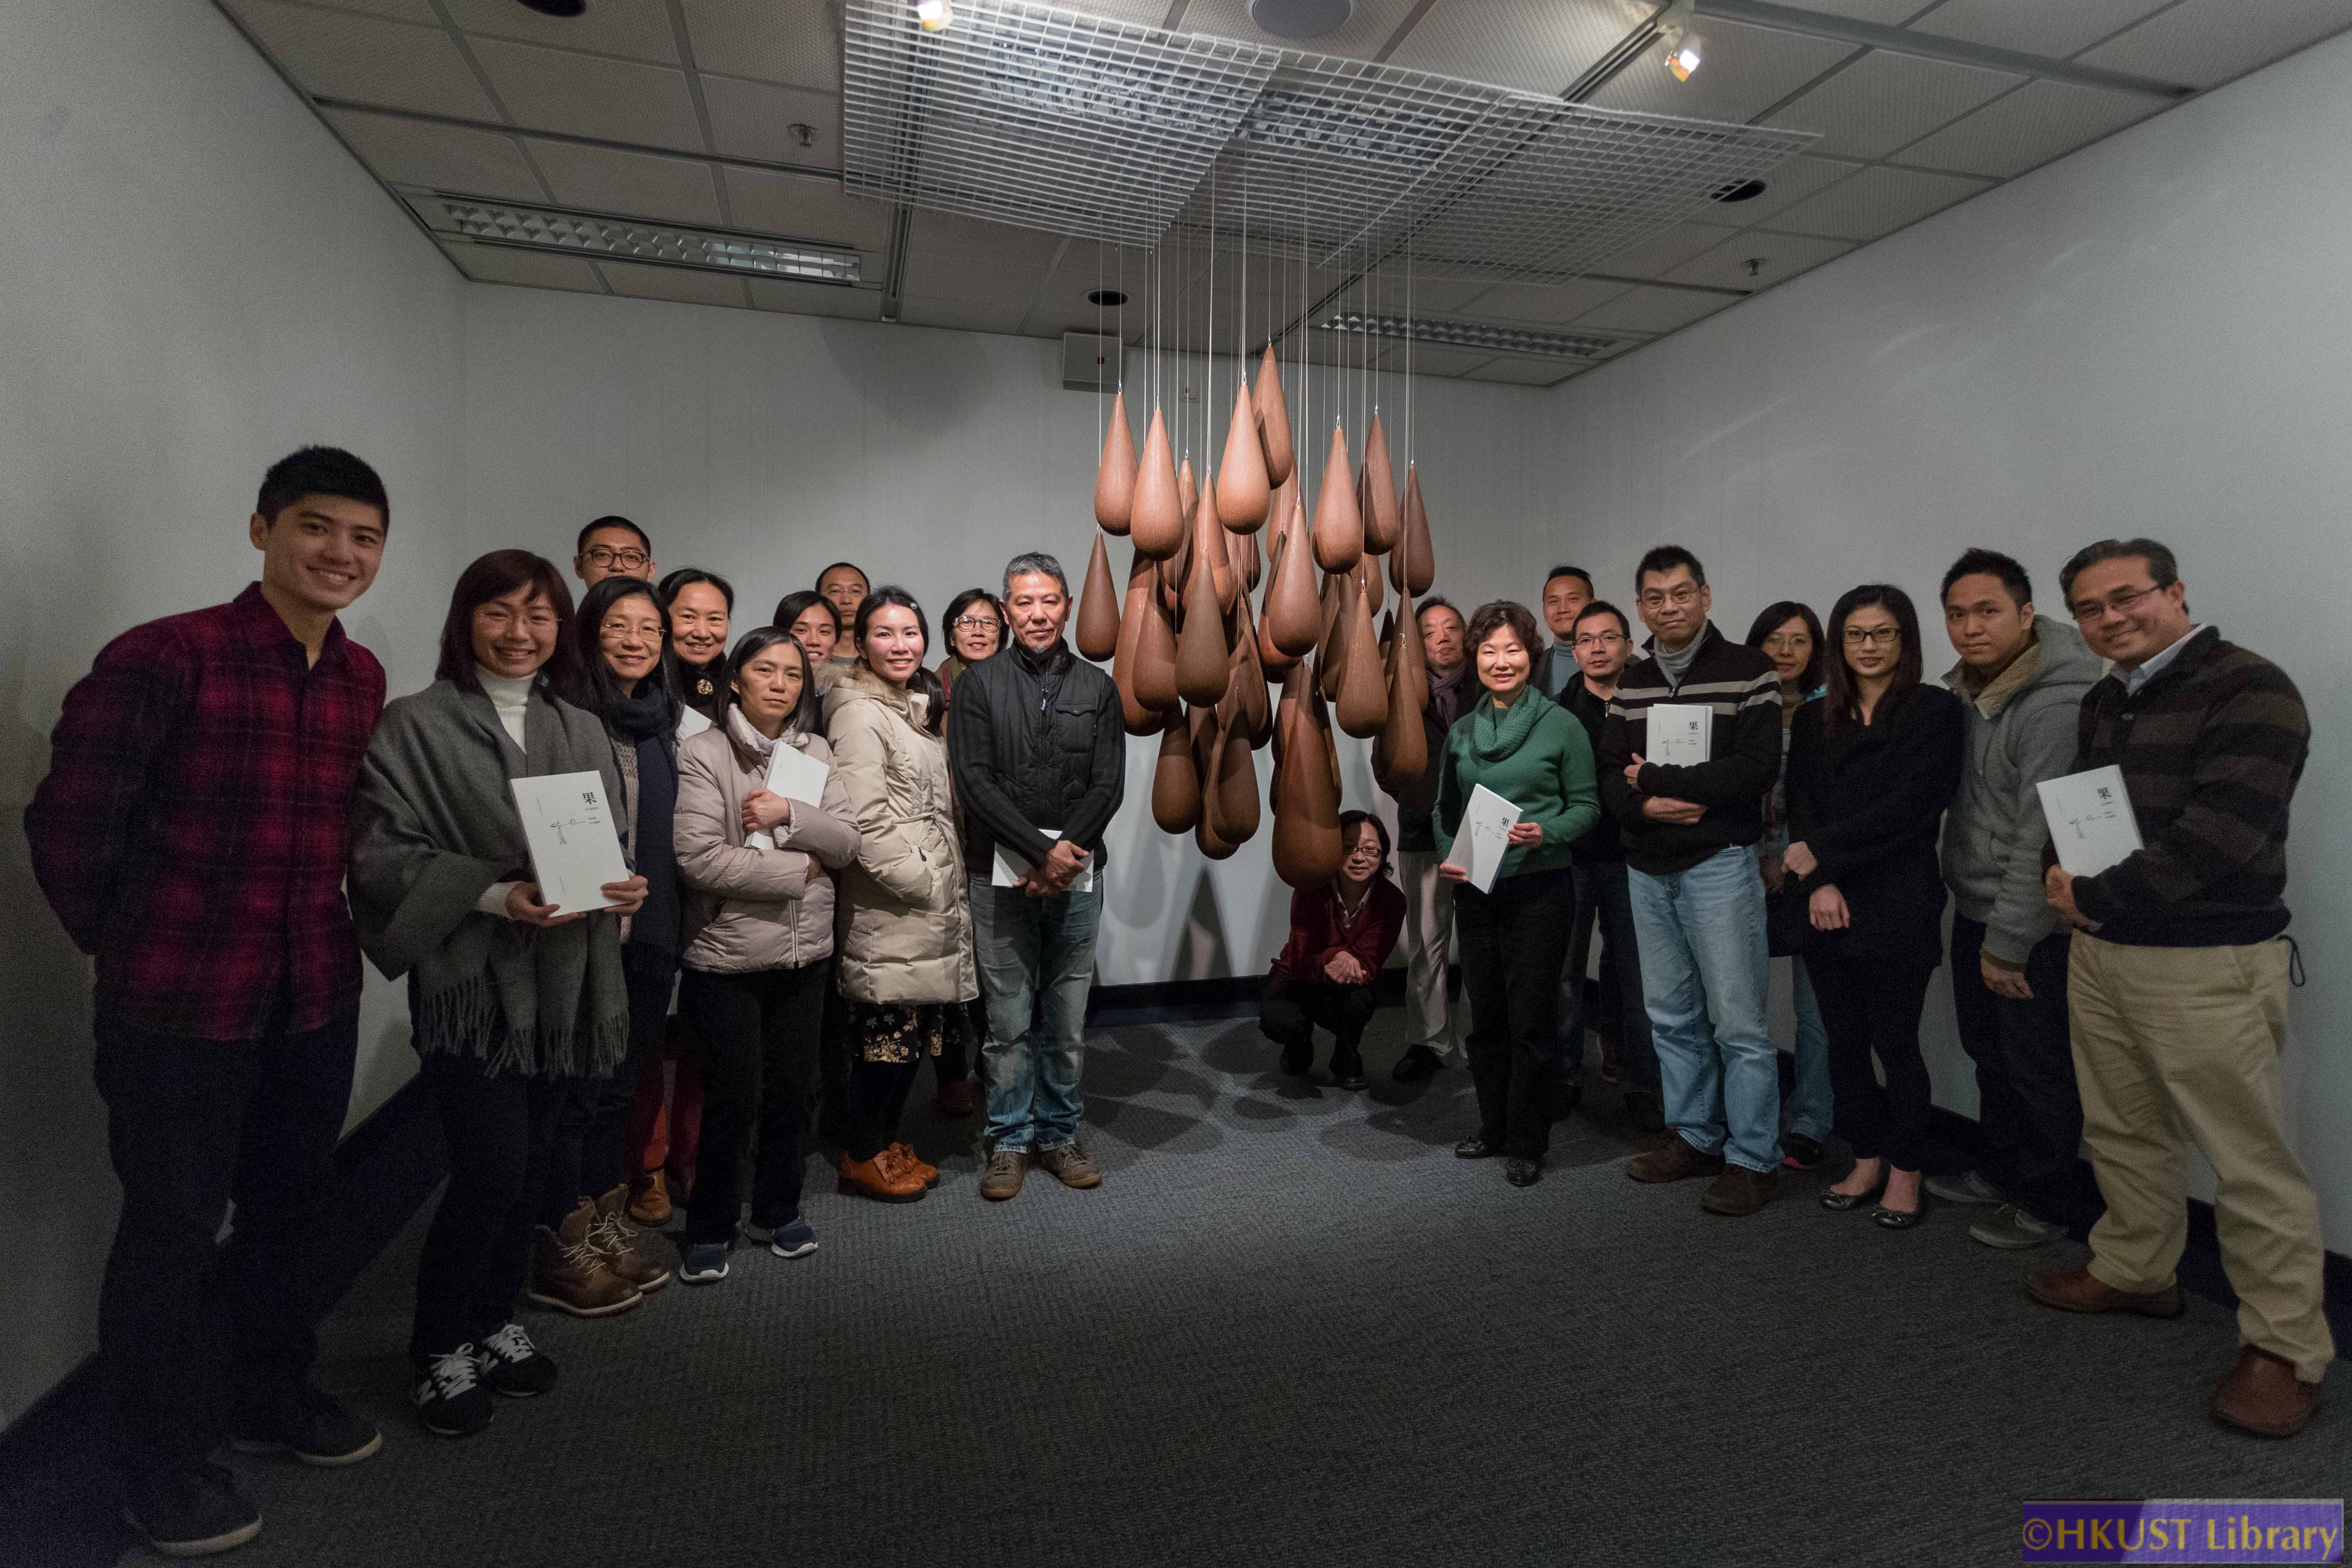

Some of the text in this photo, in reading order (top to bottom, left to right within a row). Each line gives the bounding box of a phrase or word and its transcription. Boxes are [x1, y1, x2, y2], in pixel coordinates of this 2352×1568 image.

[1689, 721, 1698, 731] 果
[582, 792, 597, 805] 果
[2097, 787, 2111, 800] 果
